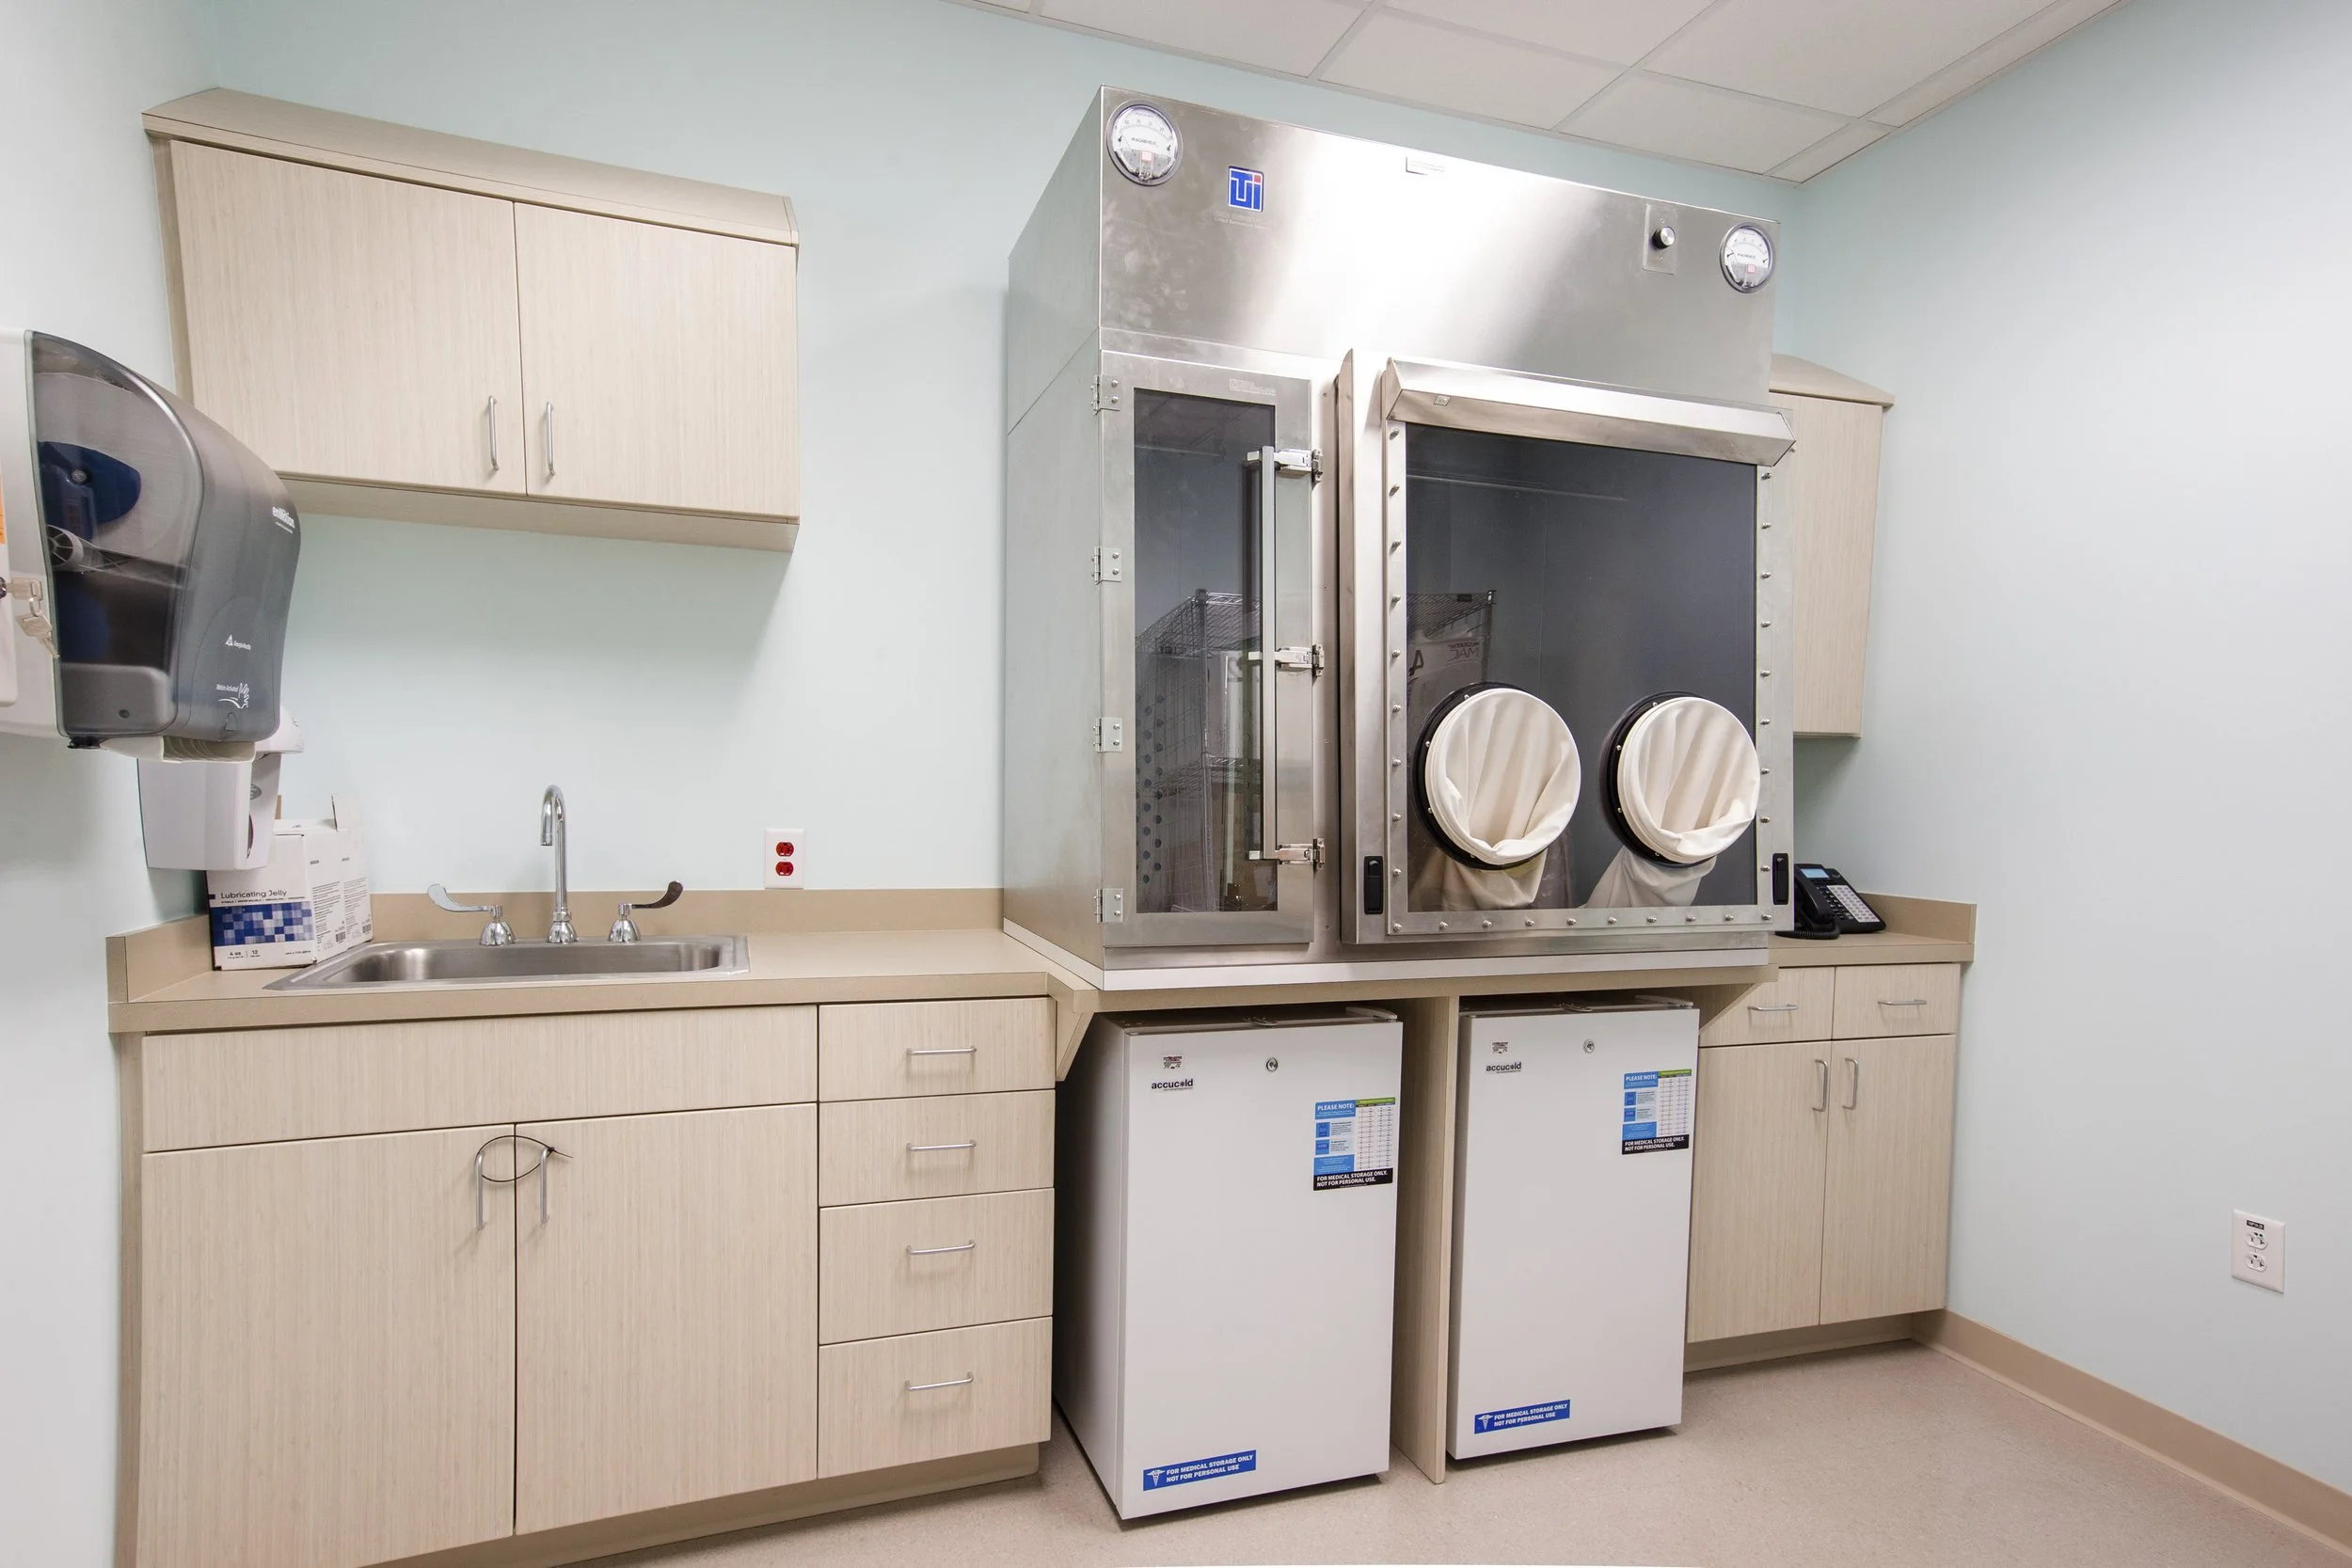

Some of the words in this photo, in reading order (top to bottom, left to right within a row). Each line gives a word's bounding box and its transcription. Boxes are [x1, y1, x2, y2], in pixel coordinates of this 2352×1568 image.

[1506, 1410, 1529, 1418] MEDICAL
[1530, 1406, 1553, 1415] STORAGE
[1517, 1414, 1545, 1423] PERSONAL
[1181, 1463, 1208, 1472] MEDICAL
[1209, 1458, 1237, 1467] STORAGE
[1238, 1454, 1253, 1463] ONLY
[1193, 1467, 1226, 1478] PERSONAL
